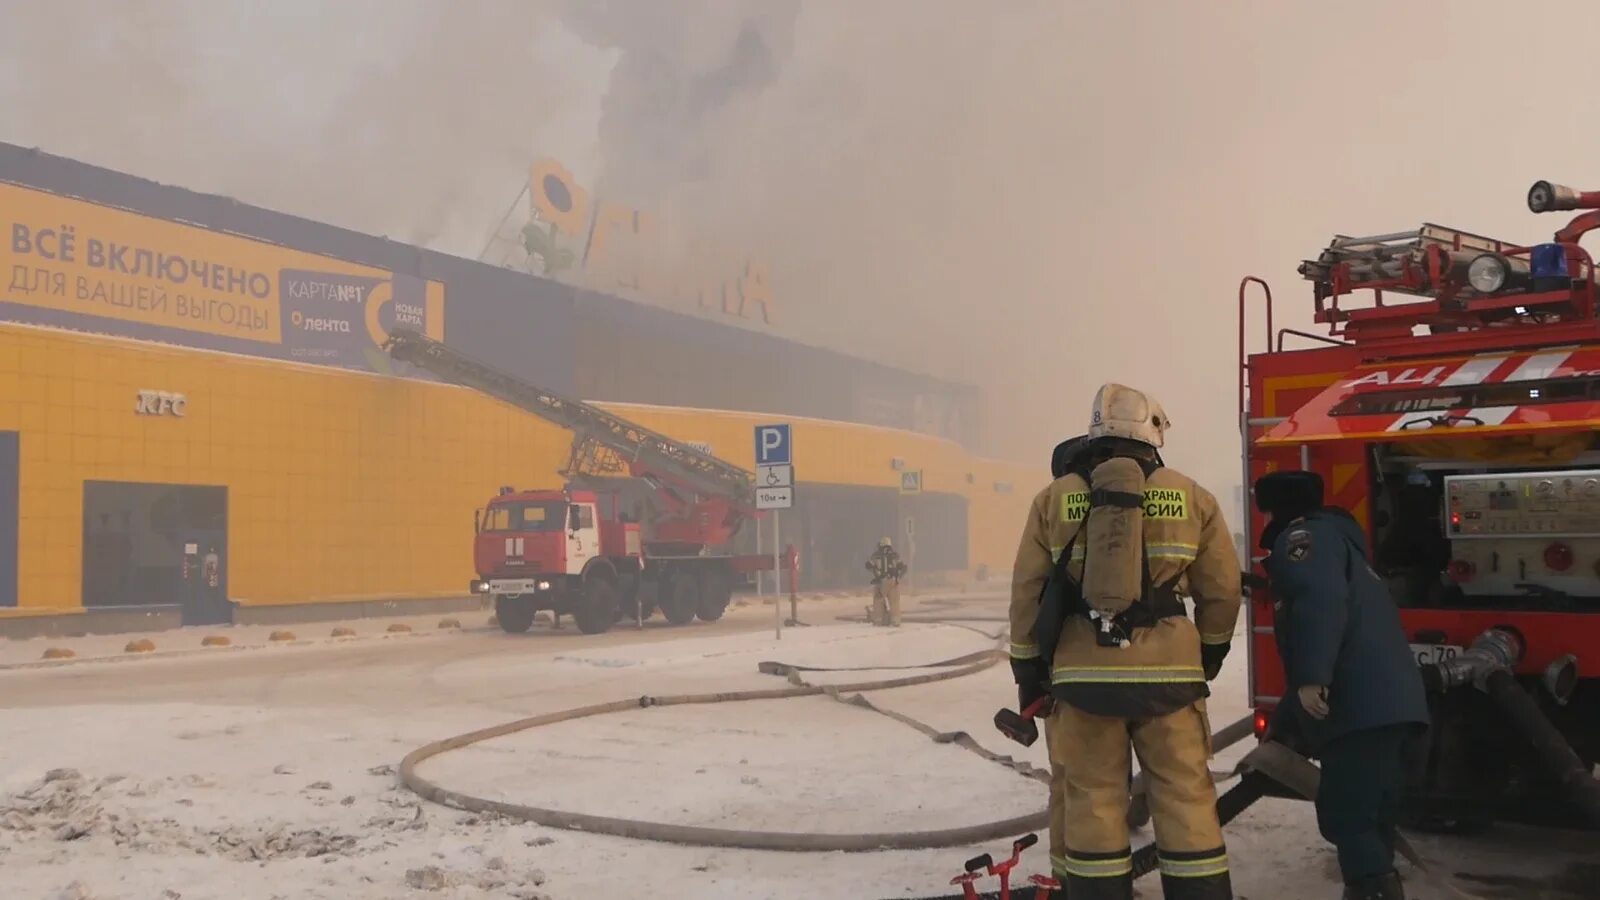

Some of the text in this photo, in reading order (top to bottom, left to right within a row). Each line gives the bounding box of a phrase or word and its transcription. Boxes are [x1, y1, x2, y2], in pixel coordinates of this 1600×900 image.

[12, 223, 270, 299] ВСЁ ВКЛЮЧЕНО
[8, 264, 269, 330] ДЛЯ ВАШЕЙ ВЫГОДЫ
[395, 303, 424, 316] НОВАЯ
[396, 312, 422, 326] КАРТА
[304, 316, 350, 333] лента
[136, 389, 186, 417] KFC
[762, 428, 781, 460] P
[1143, 489, 1182, 502] ХРАНА
